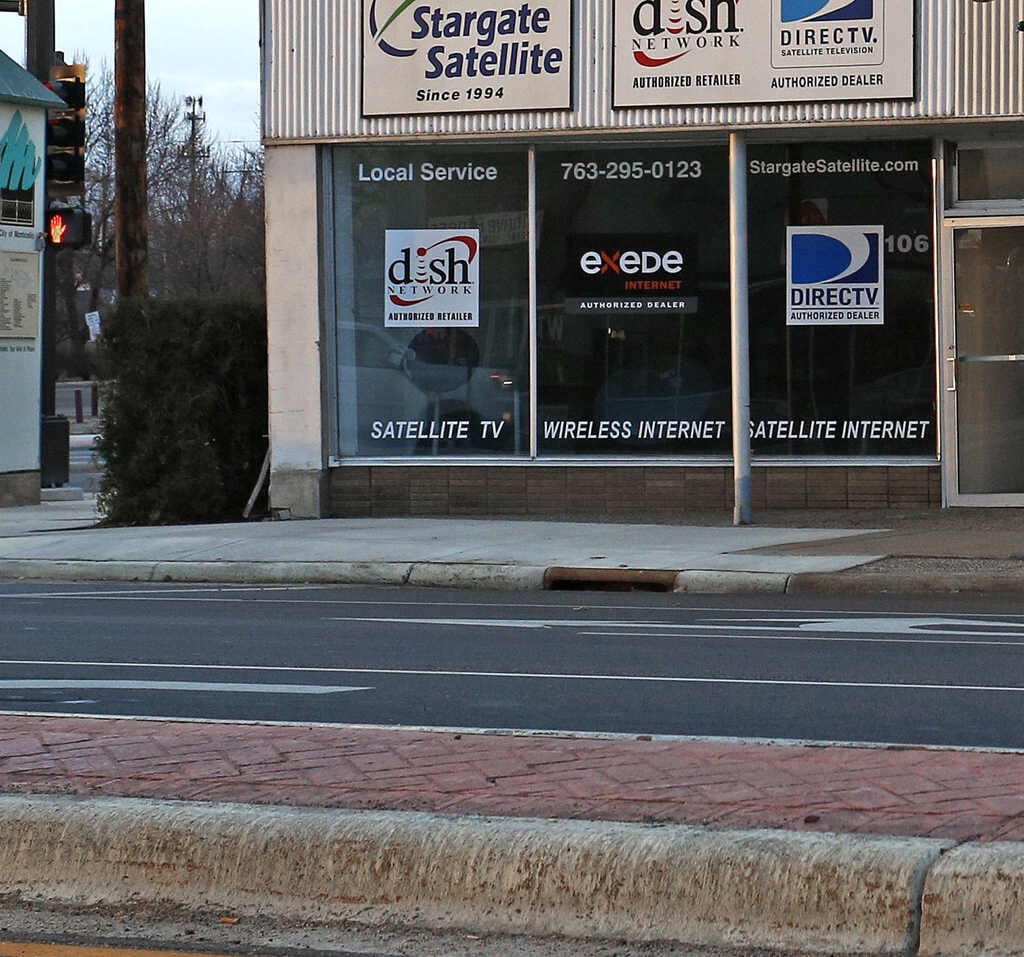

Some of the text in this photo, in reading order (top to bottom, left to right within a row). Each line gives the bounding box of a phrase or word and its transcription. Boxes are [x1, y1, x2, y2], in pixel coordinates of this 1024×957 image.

[411, 3, 550, 47] Stargate
[632, 35, 740, 50] NETWORK
[781, 45, 874, 57] SATELLITE TELEVISION
[425, 41, 563, 79] Satellite
[633, 73, 741, 89] AUTHORIZED RETAILER
[771, 73, 884, 89] AUTHORIZED DEALER
[416, 86, 504, 102] Since 1994
[359, 162, 498, 181] Local Service
[561, 160, 702, 180] 763-295-0123
[750, 159, 919, 177] StargateSatellite.com
[885, 234, 930, 253] 106
[387, 286, 472, 295] NETWORK
[625, 280, 682, 290] INTERNET
[580, 301, 686, 309] AUTHORIZED DEALER
[791, 287, 879, 306] DIRECTV
[388, 312, 473, 321] AUTHORIZED RETAILER
[790, 311, 880, 320] AUTHORIZED DEALER
[371, 420, 504, 439] SATELLITE TV
[543, 420, 725, 439] WIRELESS INTERNET
[841, 420, 930, 439] INTERNET
